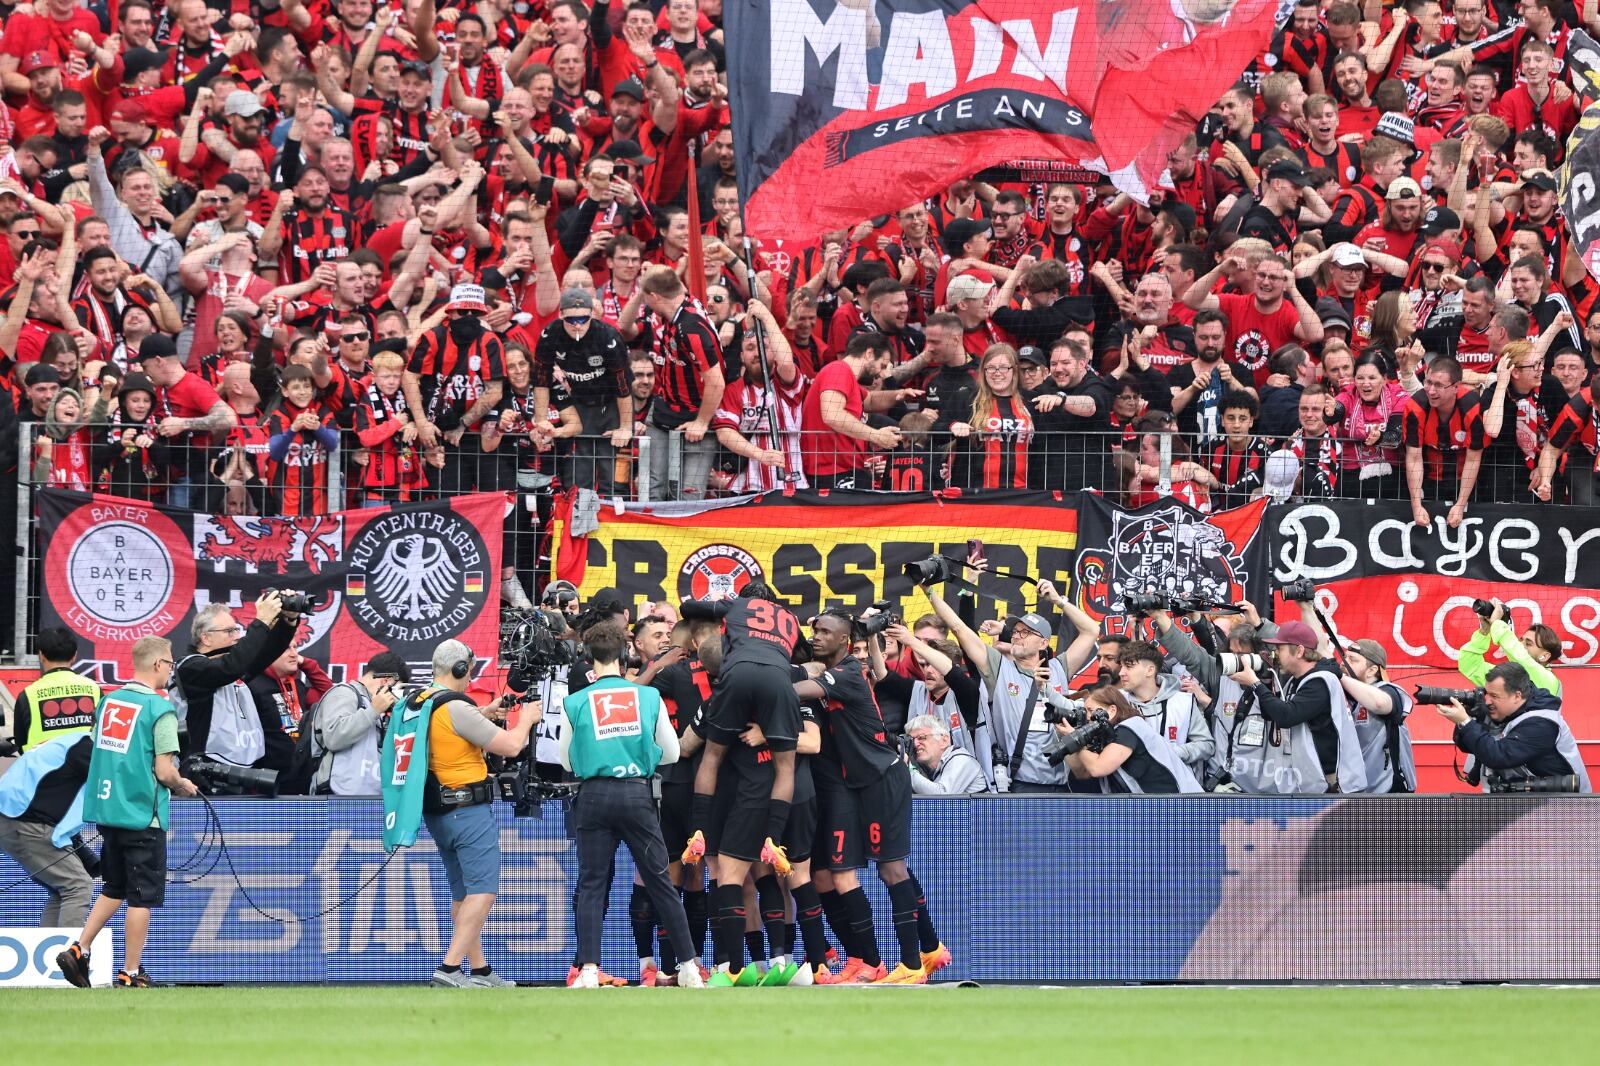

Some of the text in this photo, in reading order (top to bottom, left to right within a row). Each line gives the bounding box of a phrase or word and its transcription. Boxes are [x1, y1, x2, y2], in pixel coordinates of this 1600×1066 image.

[872, 98, 973, 138] SEITE
[994, 95, 1045, 120] AN
[889, 467, 924, 491] 10
[91, 505, 149, 524] BAYER
[350, 511, 481, 570] KUTTENTRÄGER
[1119, 541, 1174, 554] BAYER
[1142, 520, 1154, 576] BAYER
[91, 566, 153, 581] BAYER
[114, 535, 126, 612] BAYER
[682, 544, 762, 577] CROSSFIRE
[66, 606, 175, 642] LEVERKUSEN
[354, 597, 476, 642] MIT TRADITION
[746, 598, 799, 644] 30
[37, 685, 64, 699] SECURITY
[70, 684, 94, 696] SERVICE
[598, 725, 640, 736] BUNDESLIGA
[833, 822, 881, 853] 7 6
[166, 827, 572, 955] 云体育
